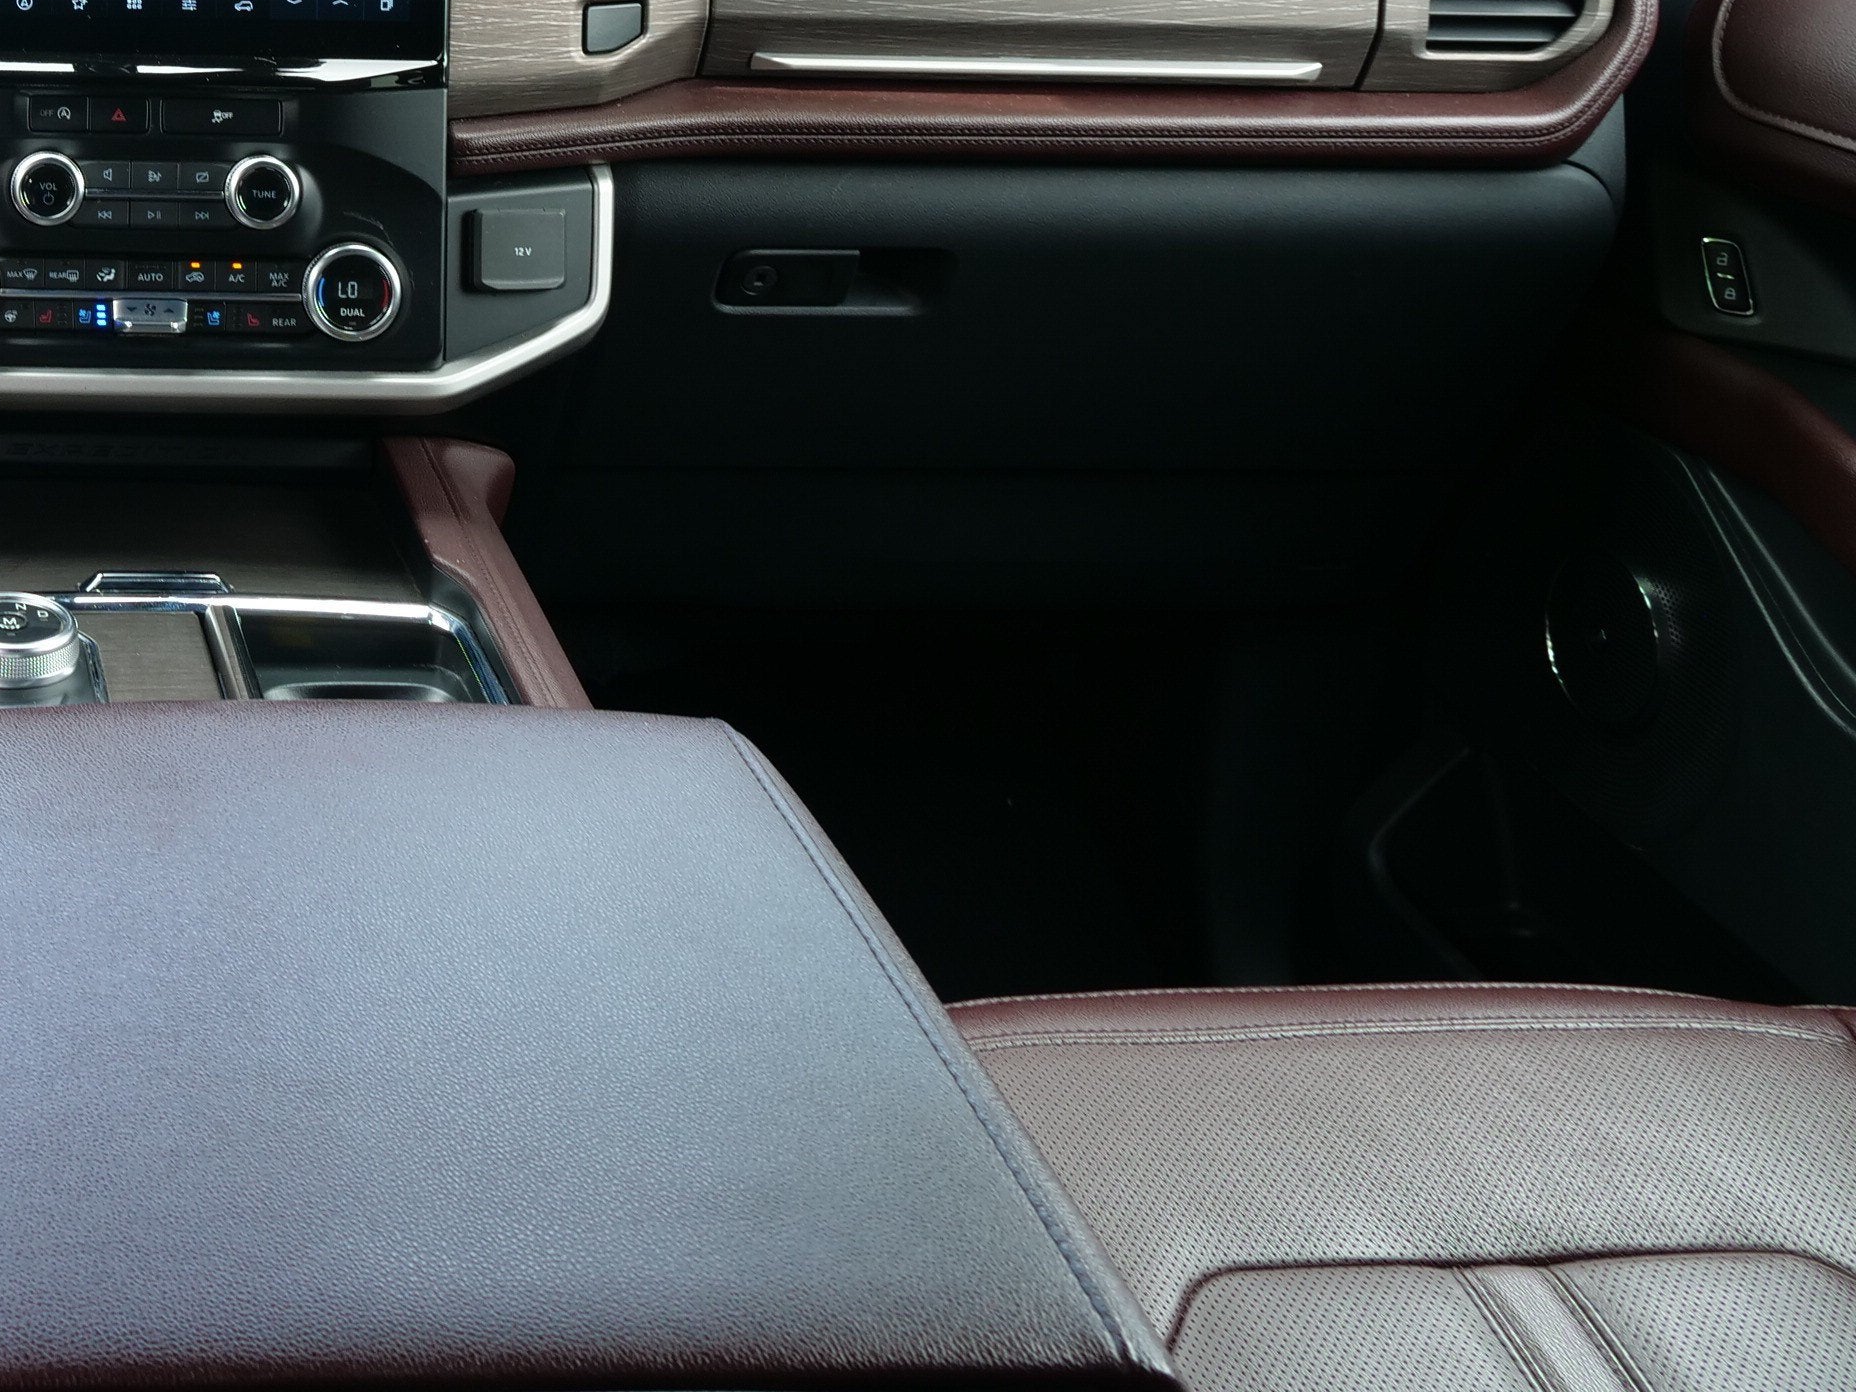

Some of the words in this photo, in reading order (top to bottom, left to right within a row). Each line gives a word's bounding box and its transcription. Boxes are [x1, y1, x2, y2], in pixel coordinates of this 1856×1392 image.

[222, 111, 233, 119] OFF
[39, 182, 58, 191] VOL
[252, 189, 277, 199] TUNE
[6, 270, 23, 279] MAX
[49, 271, 68, 280] REAR
[137, 272, 164, 282] AUTO
[228, 273, 245, 283] A/C
[269, 272, 290, 281] MAX
[271, 279, 288, 289] A/C
[340, 307, 366, 318] DUAL
[272, 317, 297, 327] REAR
[15, 603, 27, 611] N
[37, 609, 49, 618] D
[2, 617, 17, 625] M
